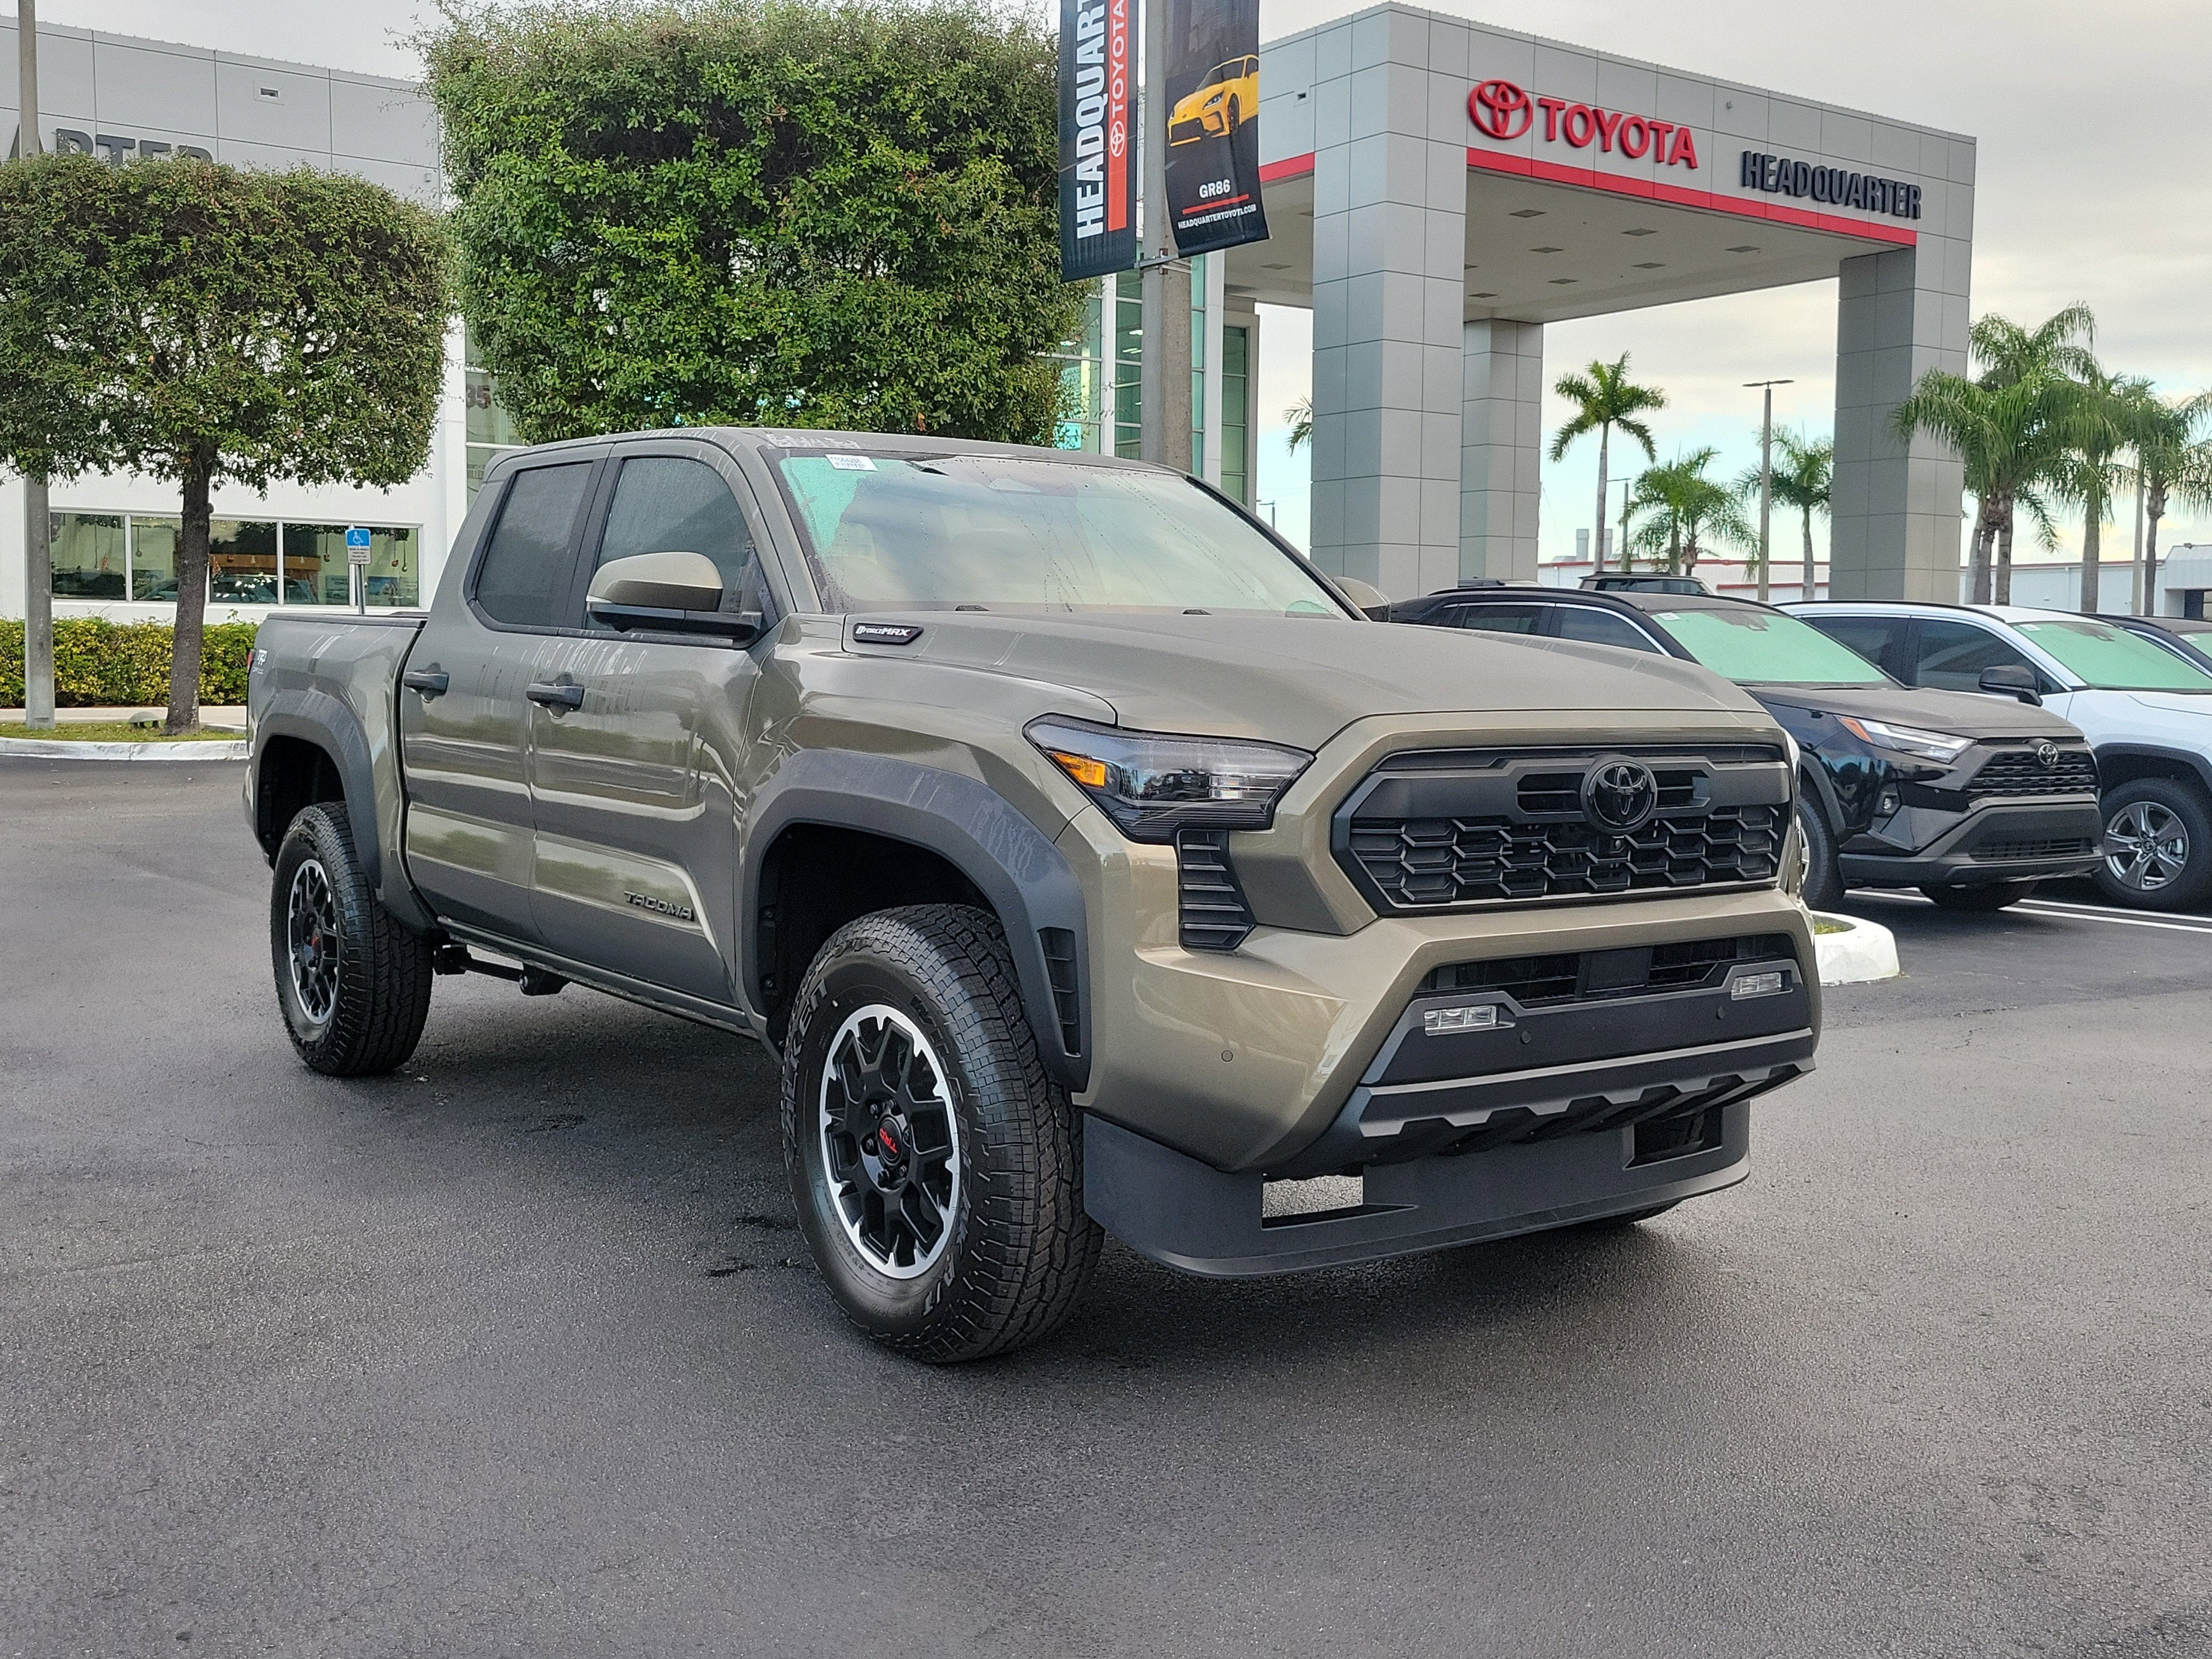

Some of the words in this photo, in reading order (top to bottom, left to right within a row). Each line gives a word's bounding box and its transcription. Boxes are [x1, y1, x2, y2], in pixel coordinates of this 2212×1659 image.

[1112, 0, 1125, 119] TOYOTA
[1199, 179, 1231, 198] GR86
[1538, 98, 1699, 169] TOYOTA
[1741, 151, 1921, 219] HEADQUARTER
[624, 890, 693, 921] TACOMA
